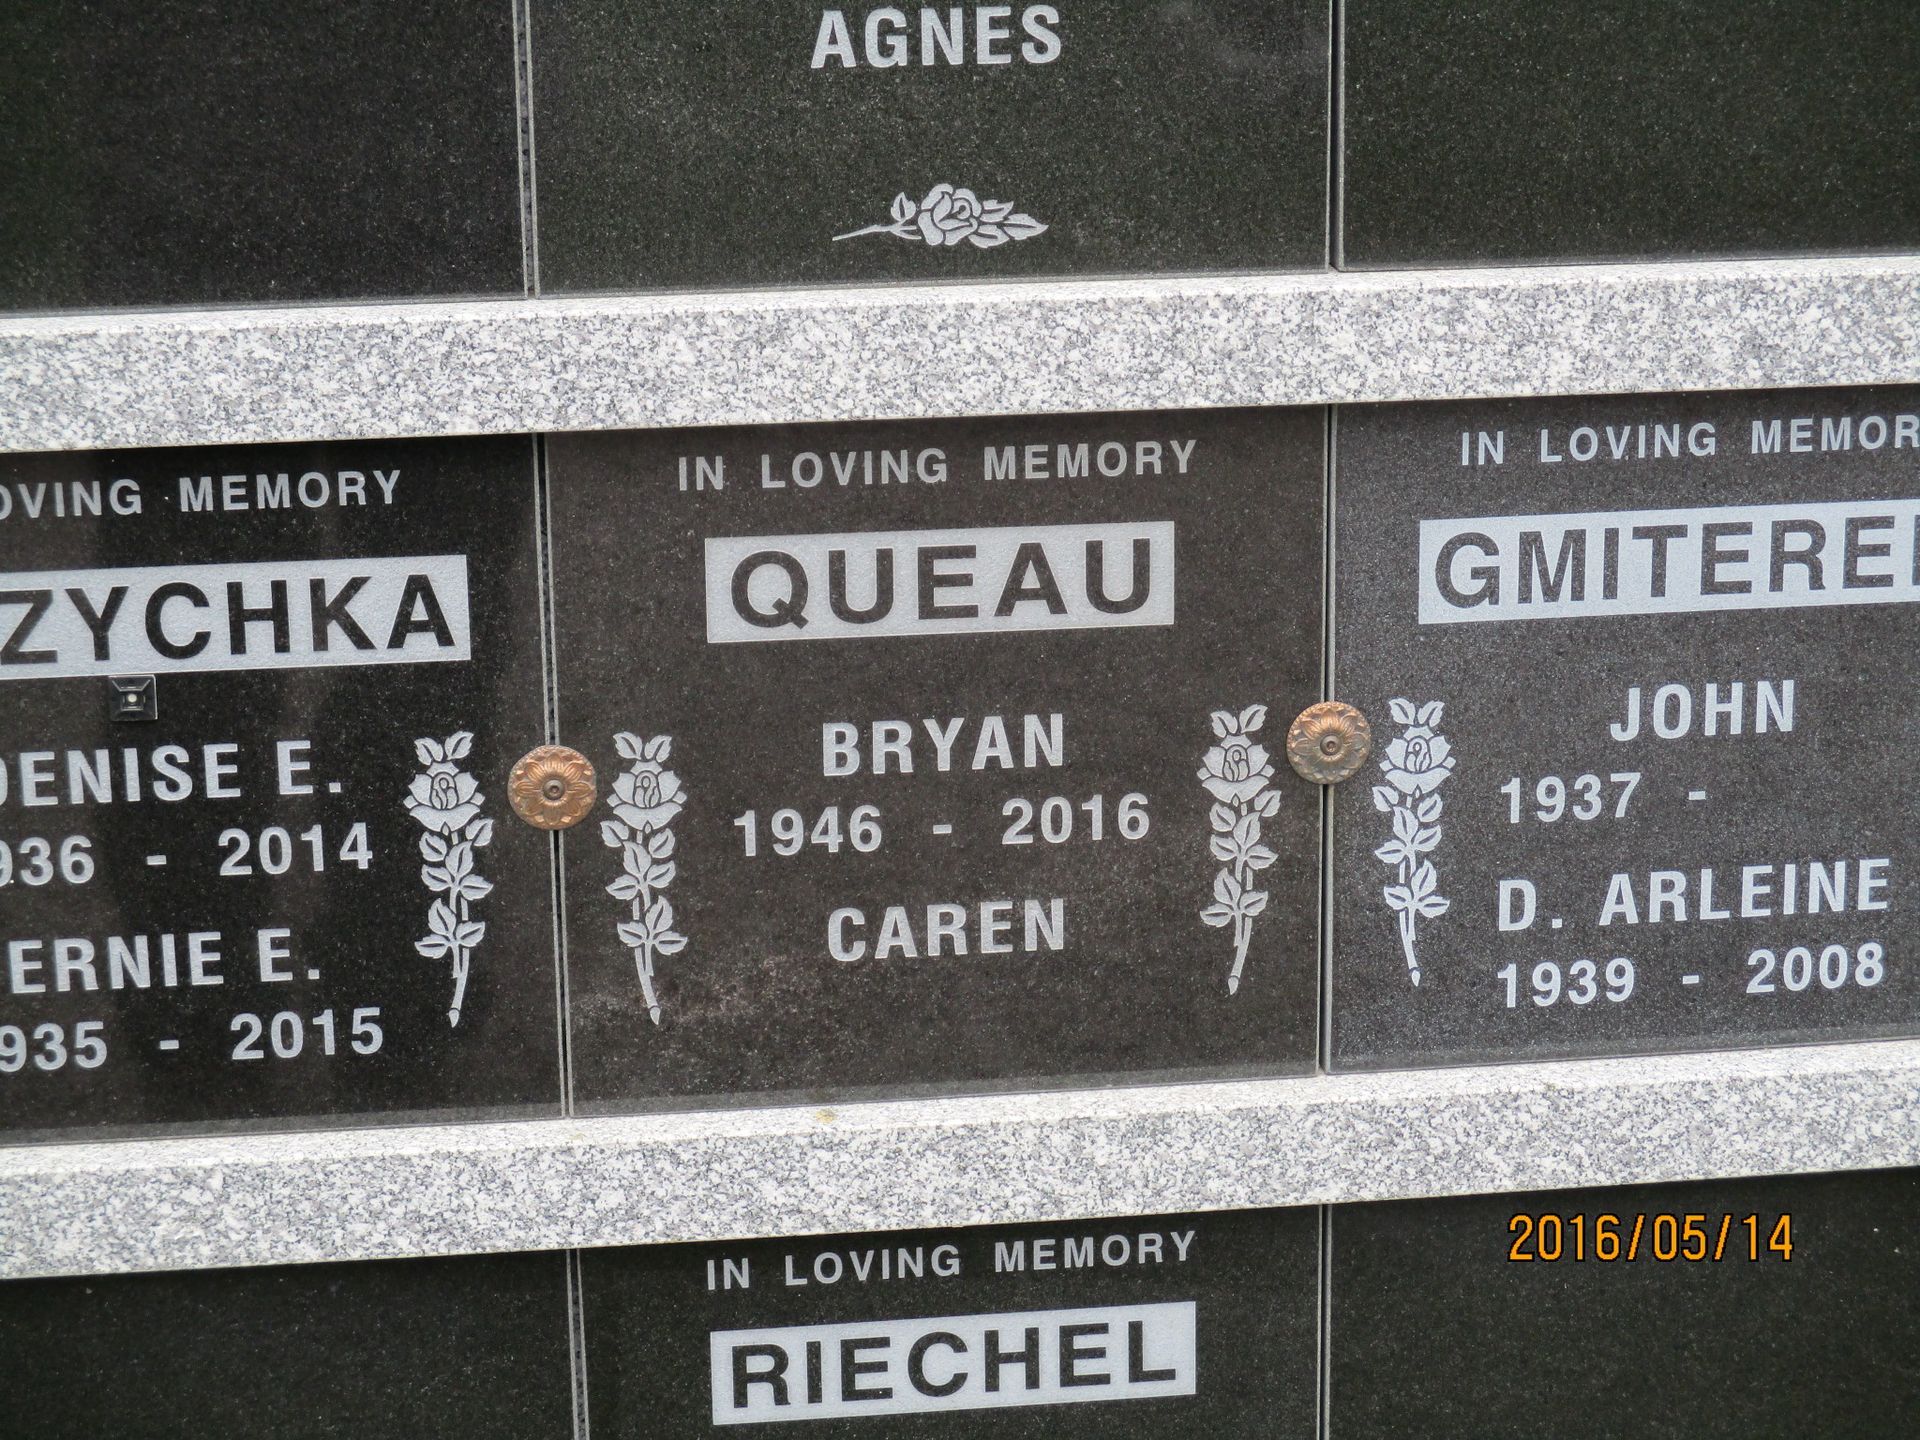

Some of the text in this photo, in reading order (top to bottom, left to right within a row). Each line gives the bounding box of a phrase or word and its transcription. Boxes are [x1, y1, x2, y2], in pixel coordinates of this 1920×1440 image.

[811, 5, 1061, 68] AGNES
[679, 440, 1195, 491] IN LOVING MEMORY
[1462, 415, 1920, 466] IN LOVING MEMOR
[180, 470, 400, 512] MEMORY
[731, 538, 1151, 629] QUEAU
[1434, 514, 1920, 608] GMITERE
[0, 574, 455, 664] ZYCHKA
[1610, 680, 1794, 741] JOHN
[0, 741, 341, 806] ENISE E.
[823, 714, 1063, 776] BRYAN
[734, 793, 1149, 856] 1946 - 2016
[1501, 772, 1706, 823] 1937 -
[147, 855, 166, 865] -
[219, 823, 373, 875] 2014
[1499, 859, 1889, 931] D. ARLEINE
[9, 928, 319, 994] ERNIE E.
[828, 899, 1064, 962] CAREN
[1498, 942, 1883, 1008] 1939 - 2008
[160, 1040, 179, 1050] -
[231, 1007, 383, 1060] 2015
[708, 1231, 1194, 1290] IN LOVING MEMORY
[732, 1321, 1176, 1409] RIECHEL
